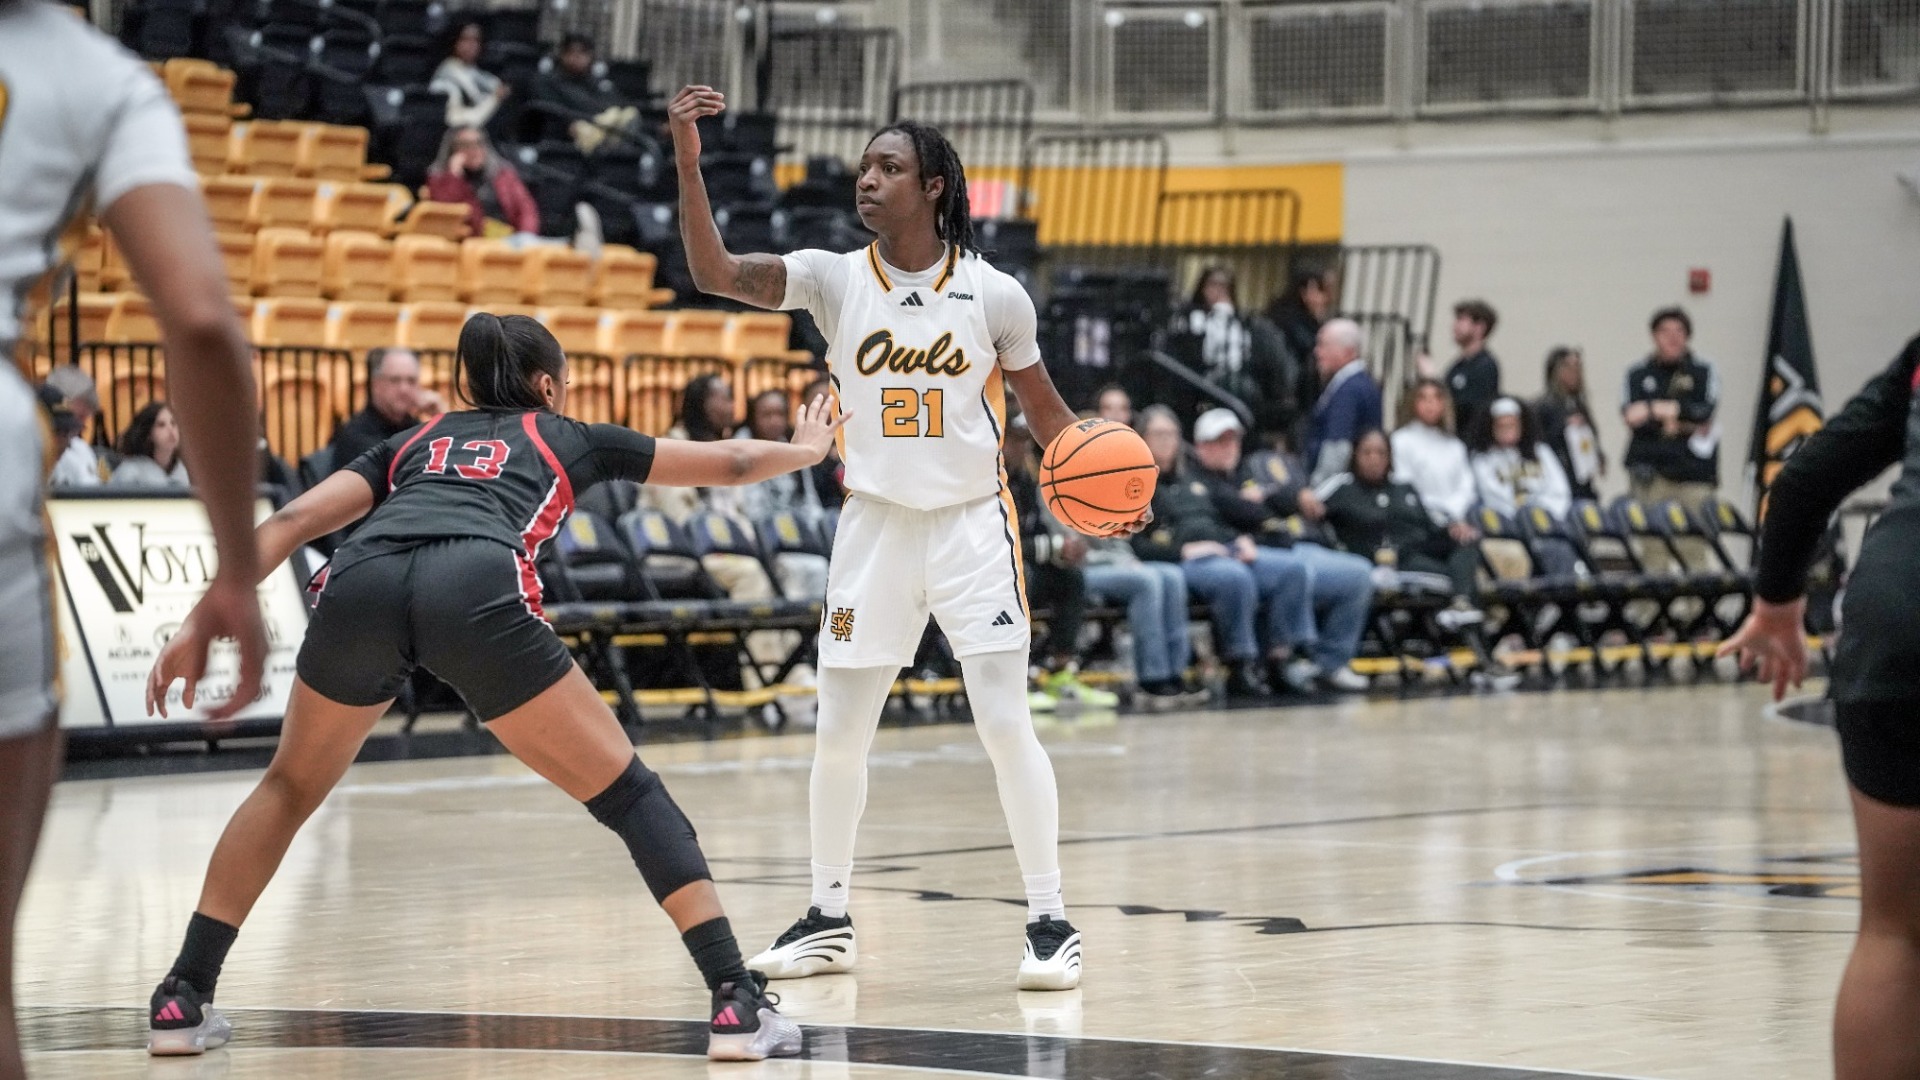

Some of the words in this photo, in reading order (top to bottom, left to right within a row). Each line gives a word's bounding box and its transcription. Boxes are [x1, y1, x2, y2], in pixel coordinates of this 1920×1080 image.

[856, 329, 971, 377] Owls
[881, 387, 944, 438] 21
[423, 436, 511, 479] 13
[92, 522, 217, 605] VOYL
